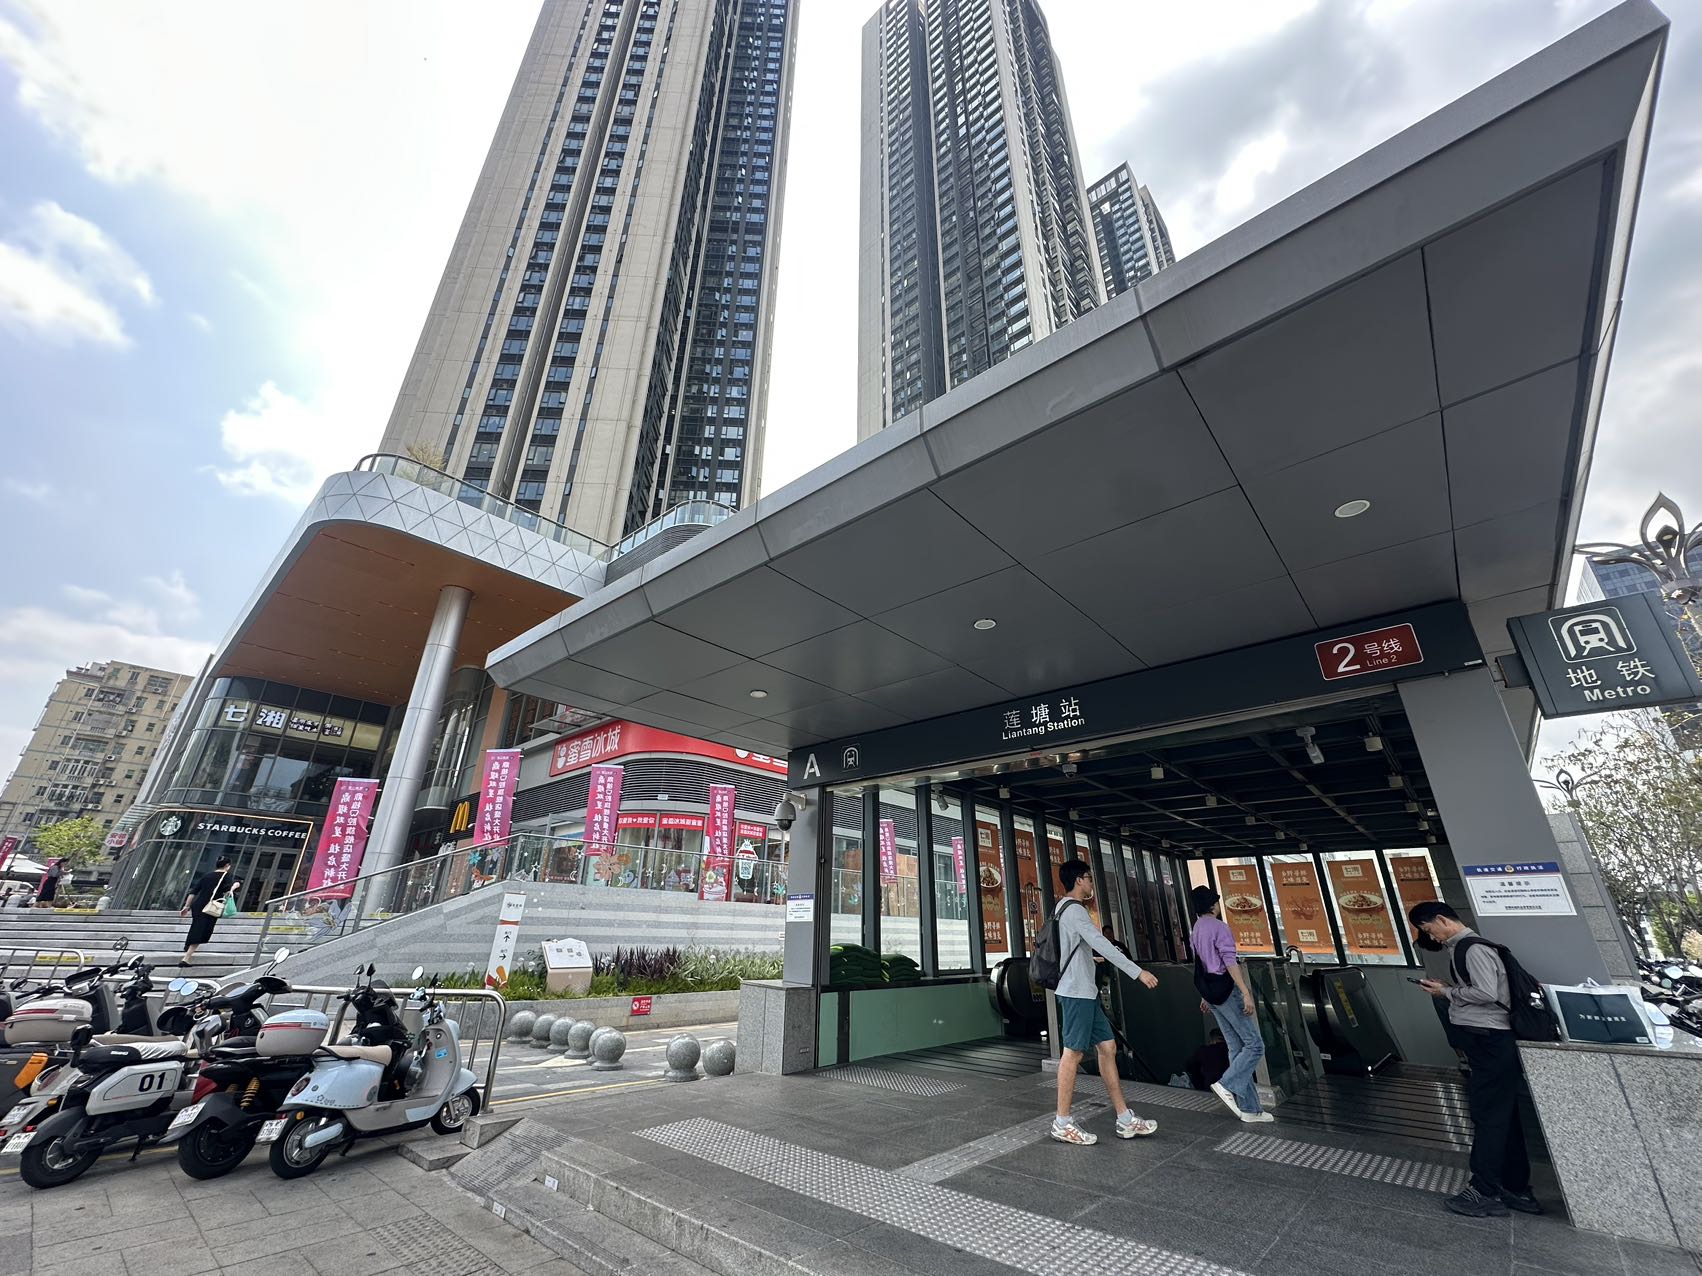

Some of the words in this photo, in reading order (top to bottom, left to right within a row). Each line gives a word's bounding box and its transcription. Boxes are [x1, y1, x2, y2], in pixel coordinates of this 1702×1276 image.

[1332, 642, 1360, 672] 2
[1364, 638, 1402, 657] 号线
[1366, 657, 1388, 667] Line
[1566, 658, 1655, 687] 地铁
[1583, 685, 1650, 701] Metro
[1003, 697, 1080, 729] 莲塘站
[1002, 725, 1045, 740] Liantang
[1047, 718, 1085, 731] Station
[566, 725, 621, 766] 蜜雪冰城
[803, 753, 820, 779] A
[197, 822, 266, 835] STARBUCKS
[268, 829, 308, 839] COFFEE
[138, 1071, 166, 1092] 01
